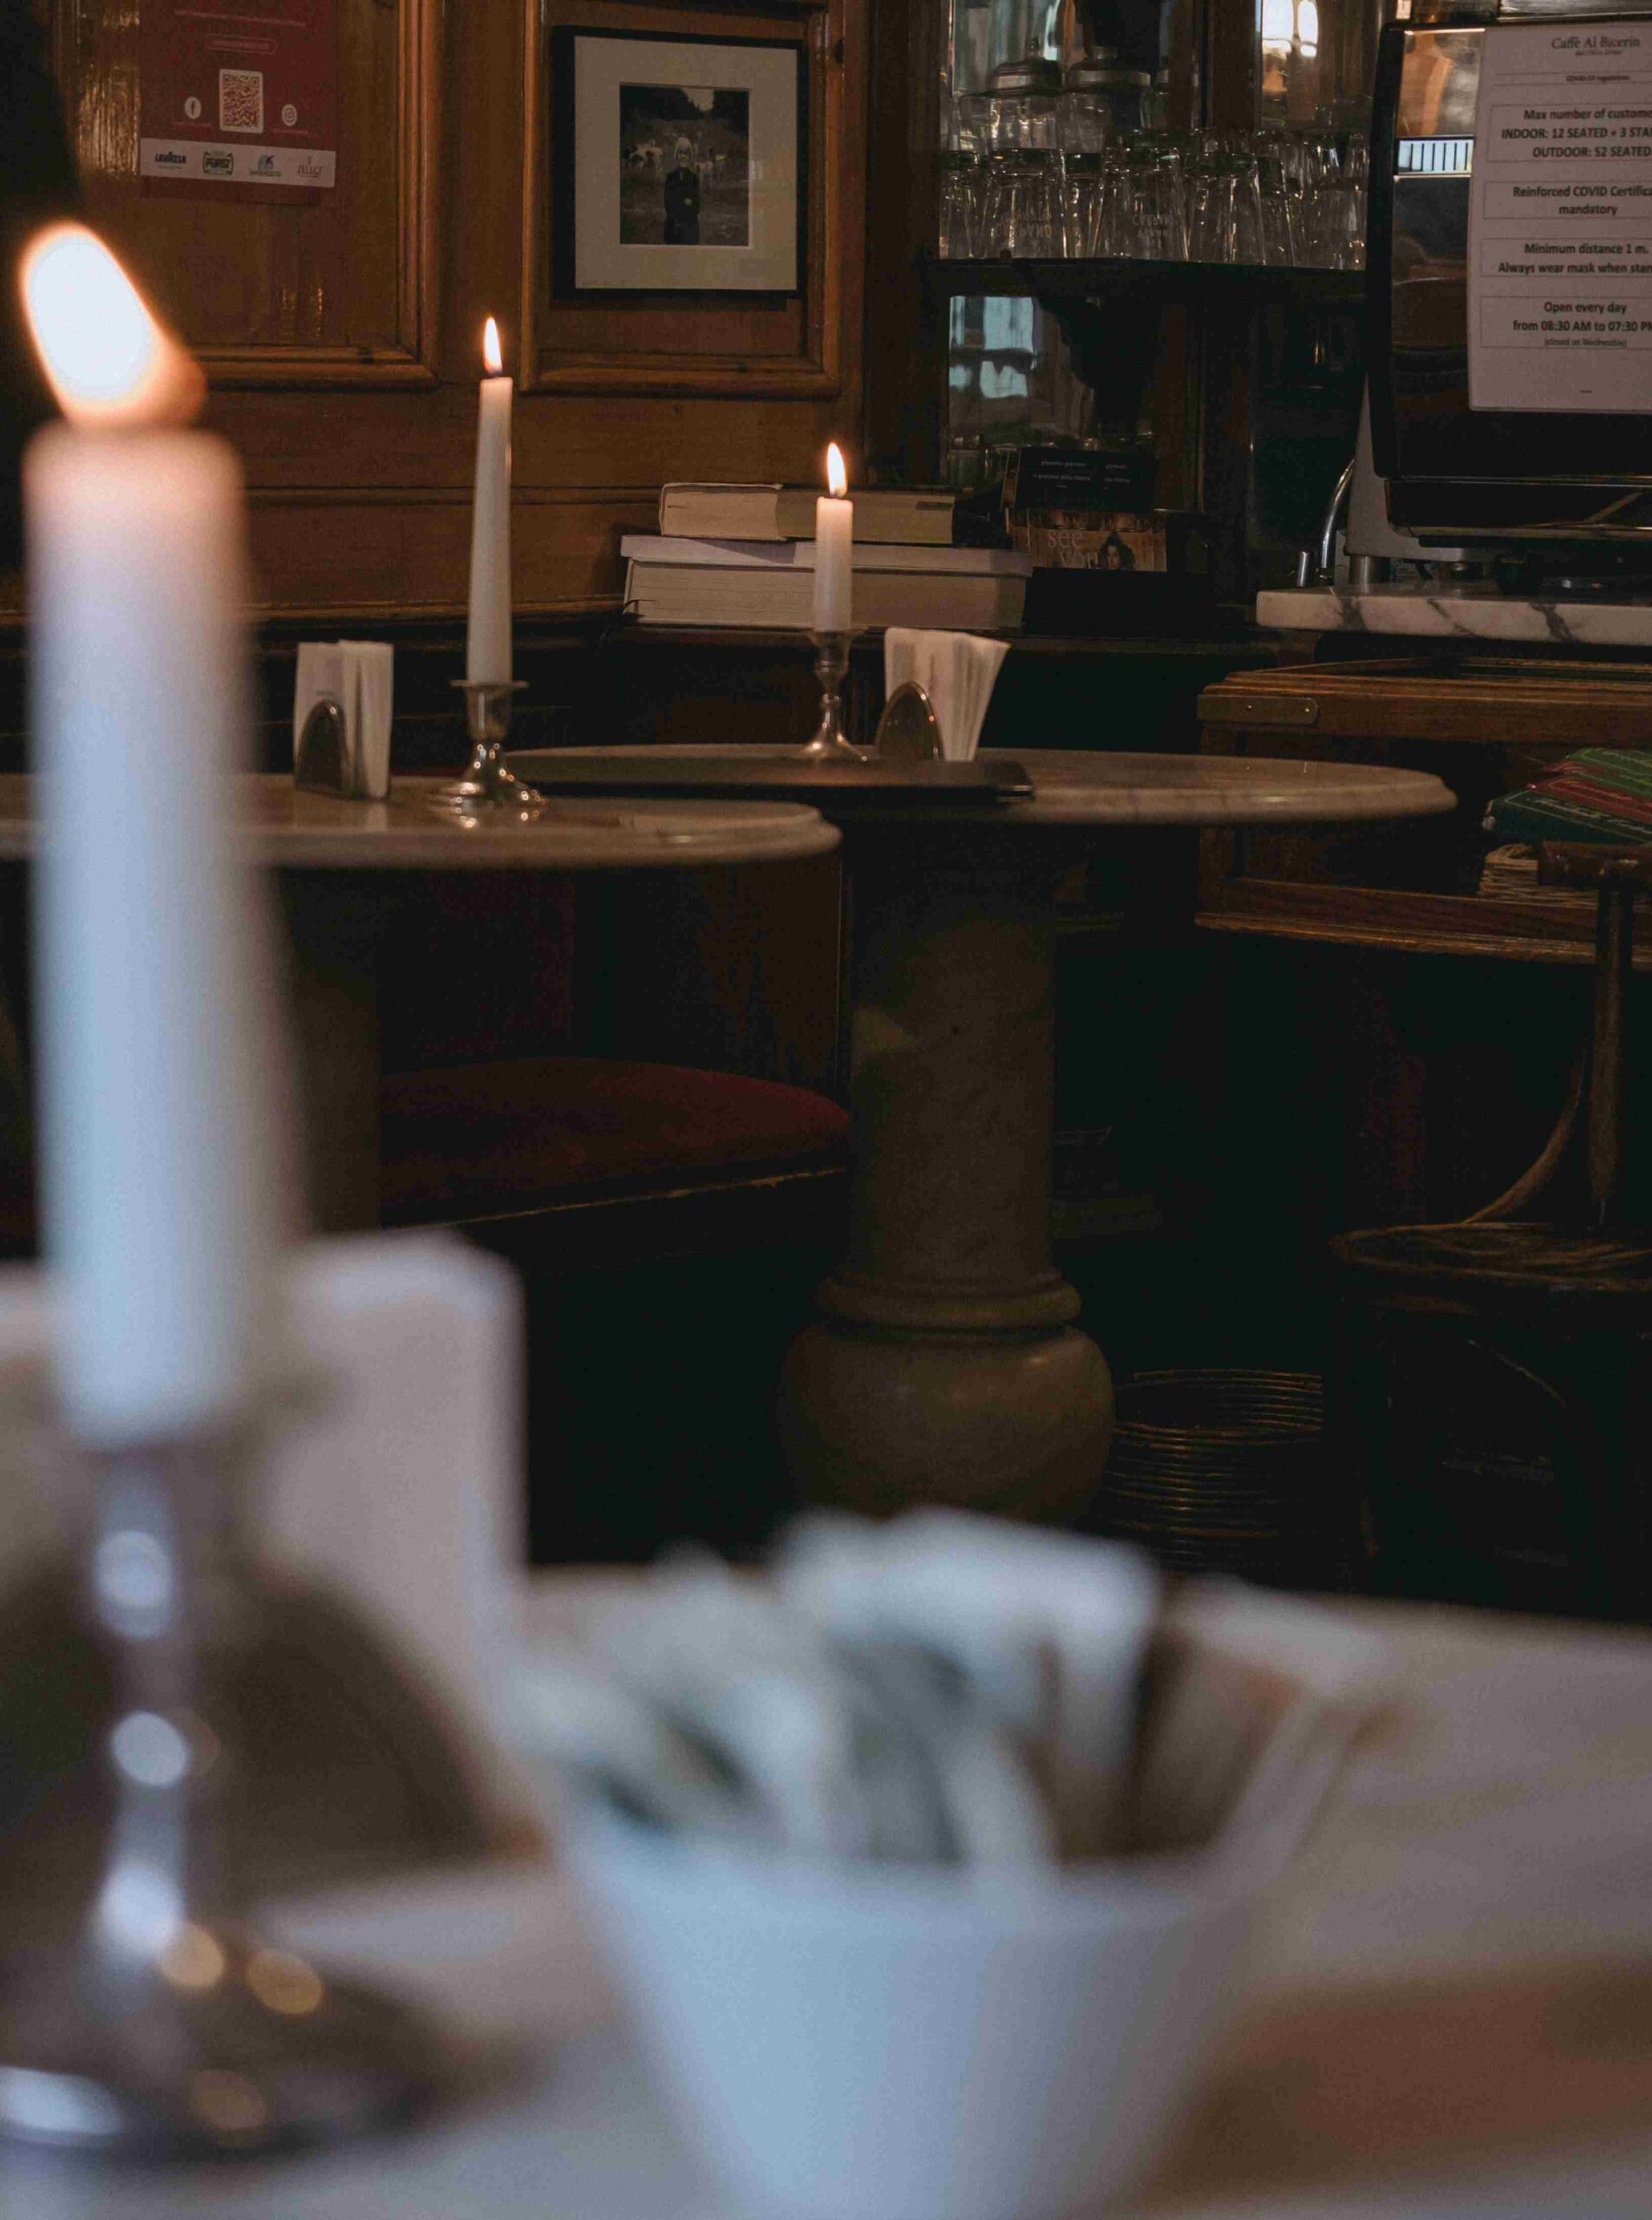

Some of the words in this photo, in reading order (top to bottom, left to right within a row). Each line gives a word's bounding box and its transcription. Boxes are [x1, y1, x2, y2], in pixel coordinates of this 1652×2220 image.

[1583, 36, 1596, 48] Al
[1524, 110, 1546, 120] Max
[1550, 109, 1590, 120] number
[1593, 108, 1606, 119] of
[1501, 128, 1548, 139] INDOOR:
[1551, 128, 1564, 138] 12
[1567, 127, 1608, 138] SEATED
[1619, 127, 1627, 138] 3
[1532, 147, 1592, 157] OUTDOOR:
[1595, 147, 1607, 157] 52
[1610, 147, 1651, 156] SEATED
[1513, 186, 1570, 197] Reinforced
[1573, 186, 1607, 196] COVID
[1558, 205, 1617, 216] mandatory
[1525, 244, 1576, 253] Minimum
[1578, 244, 1623, 253] distance
[1626, 244, 1632, 253] 1
[1499, 263, 1535, 275] Always
[1567, 263, 1596, 272] mask
[1598, 263, 1627, 272] when
[1544, 302, 1572, 314] Open
[1575, 304, 1604, 314] every
[1608, 303, 1627, 314] day
[1513, 320, 1538, 330] from
[1541, 321, 1570, 330] 08:30
[1573, 322, 1591, 330] AM
[1595, 322, 1606, 331] to
[1608, 321, 1637, 331] 07:30
[1047, 530, 1085, 549] see
